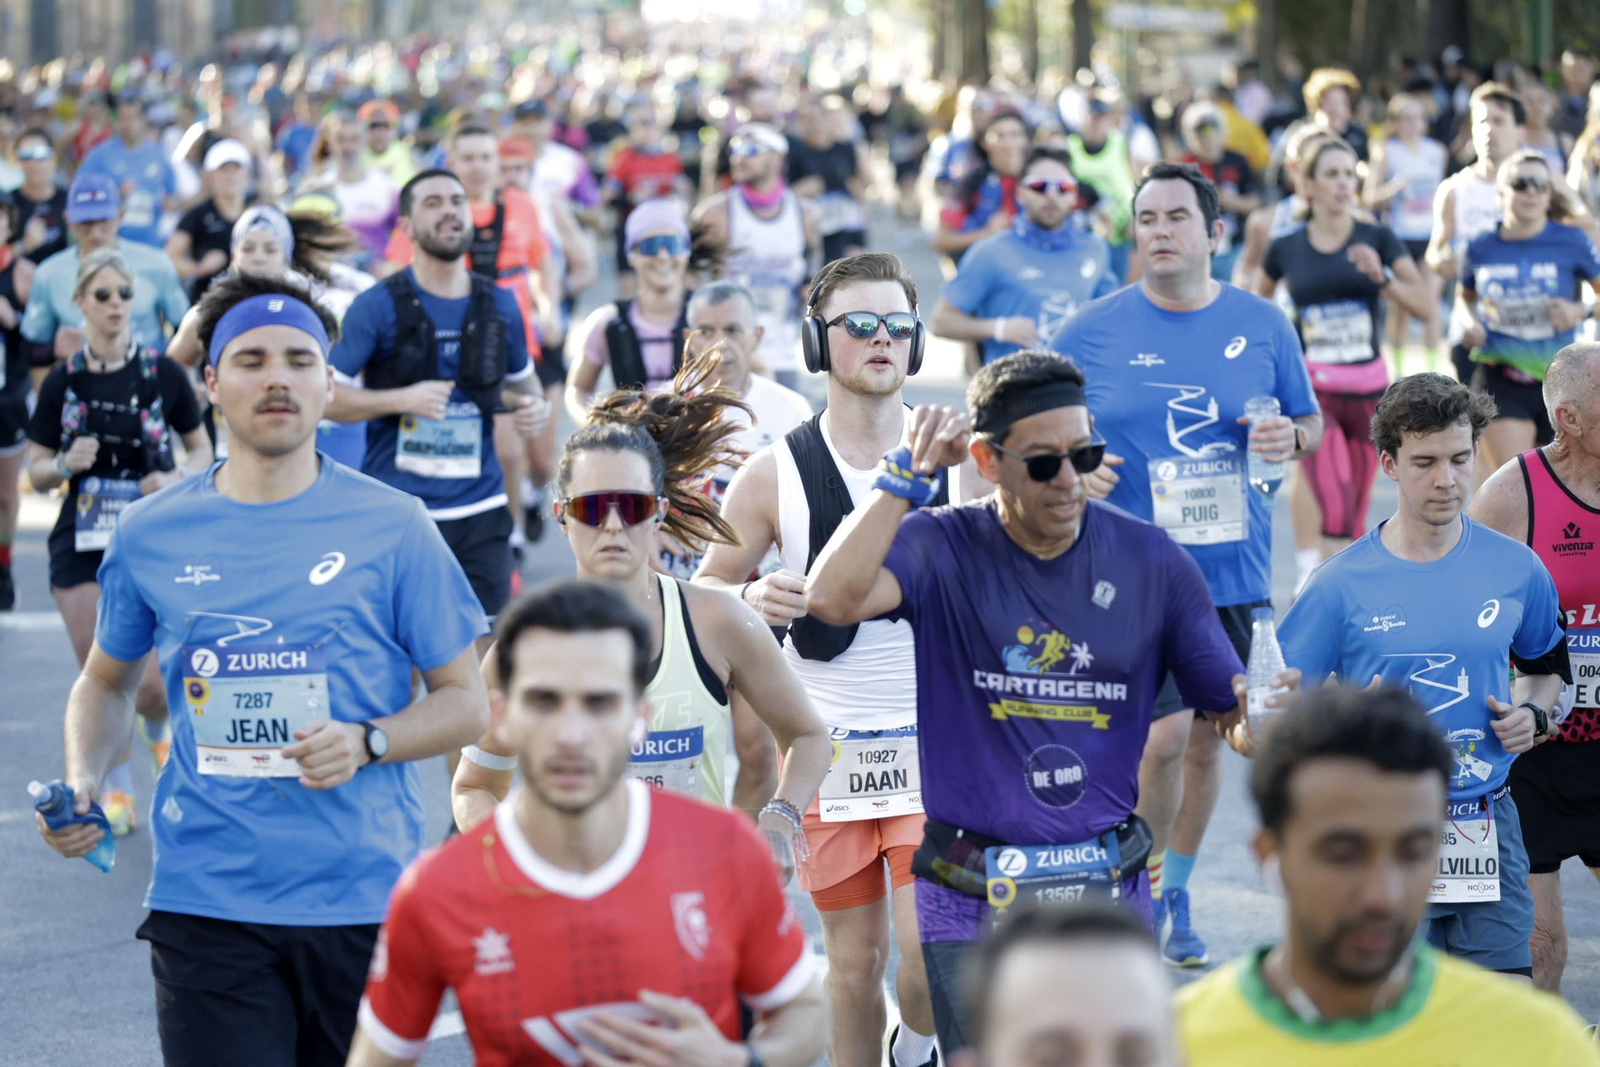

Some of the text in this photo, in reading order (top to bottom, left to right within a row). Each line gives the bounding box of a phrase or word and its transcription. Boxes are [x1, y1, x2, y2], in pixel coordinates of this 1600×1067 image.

[1182, 460, 1232, 475] ZURICH
[1181, 504, 1218, 523] PUIG
[1552, 541, 1593, 552] vivenzia
[1581, 604, 1600, 625] L
[227, 652, 307, 671] ZURICH
[973, 669, 1127, 701] CARTAGENA
[233, 692, 273, 709] 7287
[1006, 702, 1093, 717] RUNNING CLUB
[226, 718, 289, 743] JEAN
[630, 737, 690, 756] URICH
[857, 750, 898, 764] 10927
[849, 769, 908, 793] DAAN
[1032, 765, 1082, 788] DE ORO
[1441, 832, 1457, 845] 85
[1036, 846, 1108, 868] ZURICH
[1035, 884, 1086, 905] 13567
